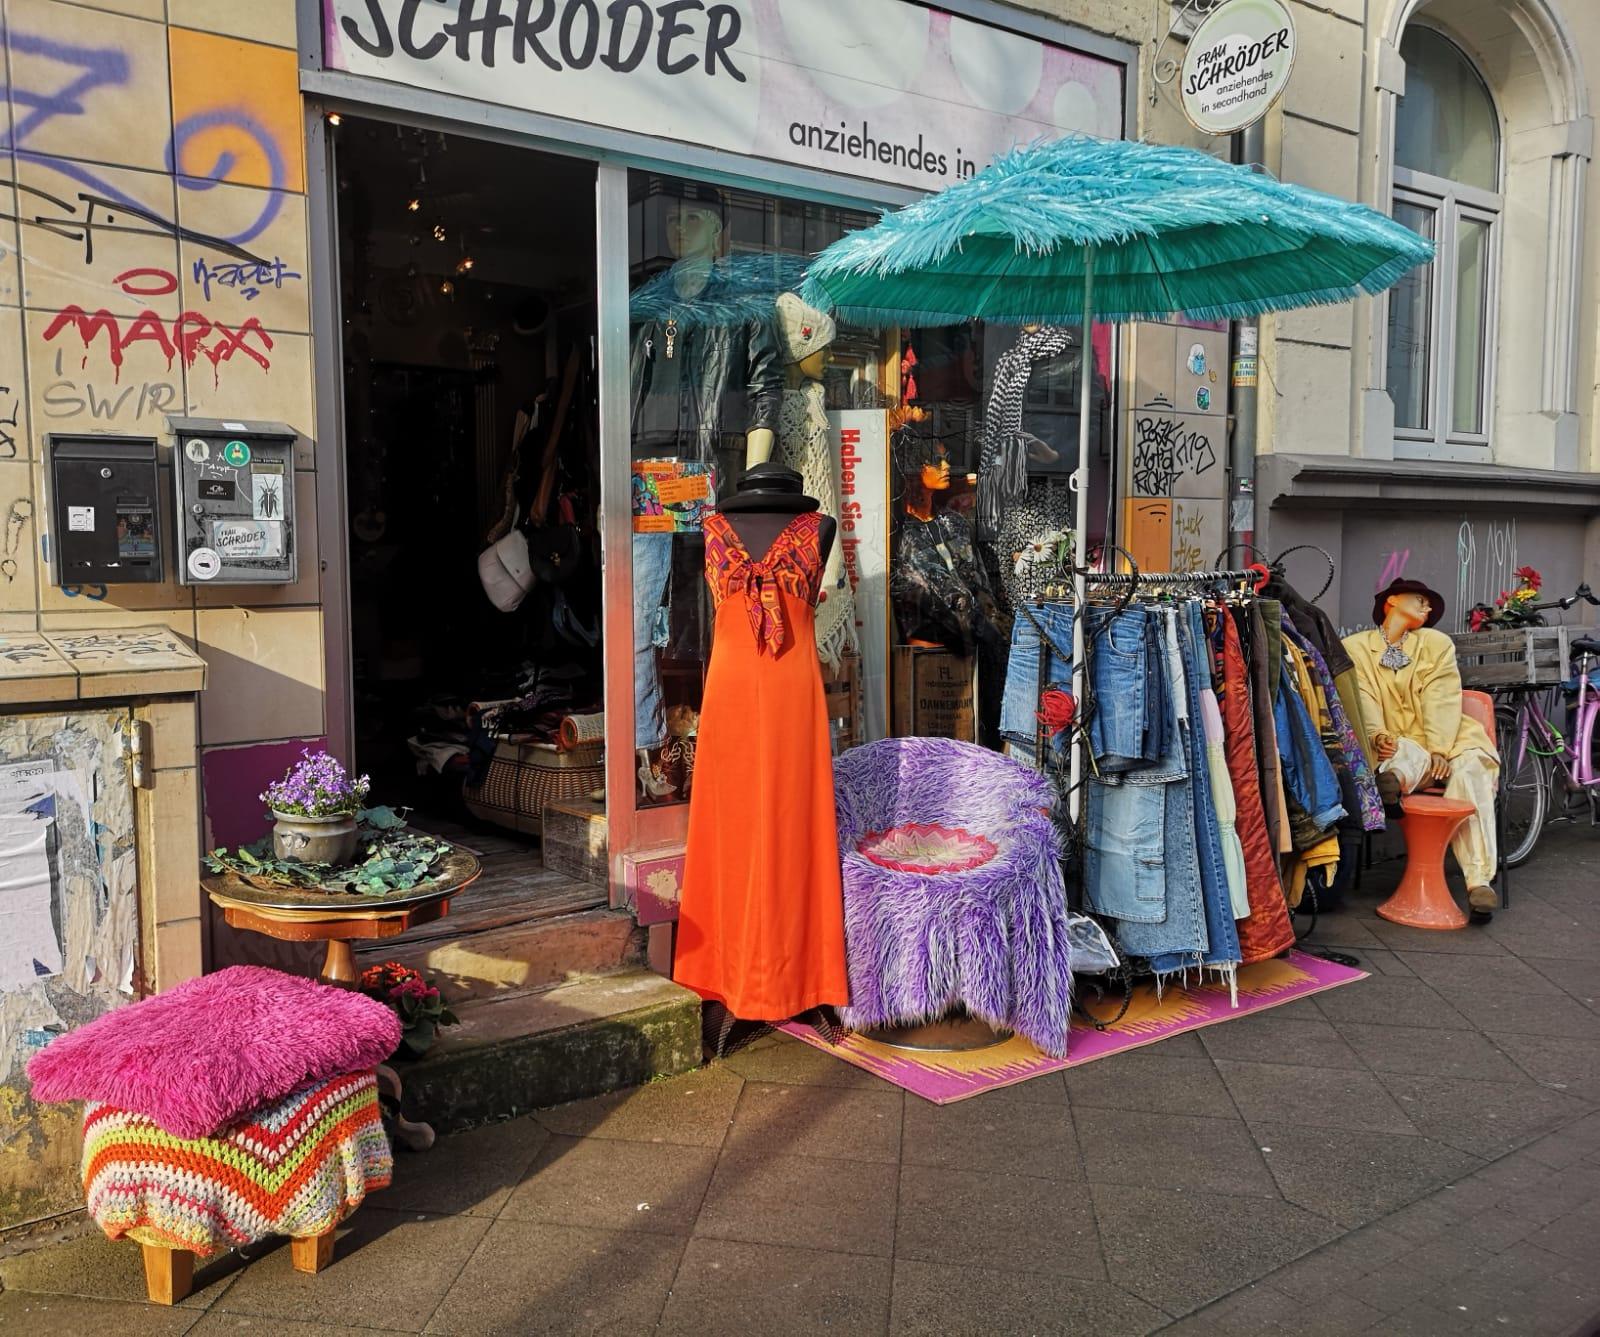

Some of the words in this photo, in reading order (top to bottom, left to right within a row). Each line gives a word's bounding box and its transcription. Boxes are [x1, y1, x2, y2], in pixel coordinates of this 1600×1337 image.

[1186, 28, 1290, 95] SCHRÖDER
[1197, 43, 1227, 69] FRAU
[1216, 68, 1274, 96] anziehendes
[1201, 103, 1210, 113] in
[1212, 83, 1268, 111] secondhand
[789, 121, 947, 176] anziehendes
[956, 147, 976, 180] in
[840, 429, 862, 496] Haben
[840, 502, 863, 532] Sie
[216, 530, 266, 547] SCHRÖDER
